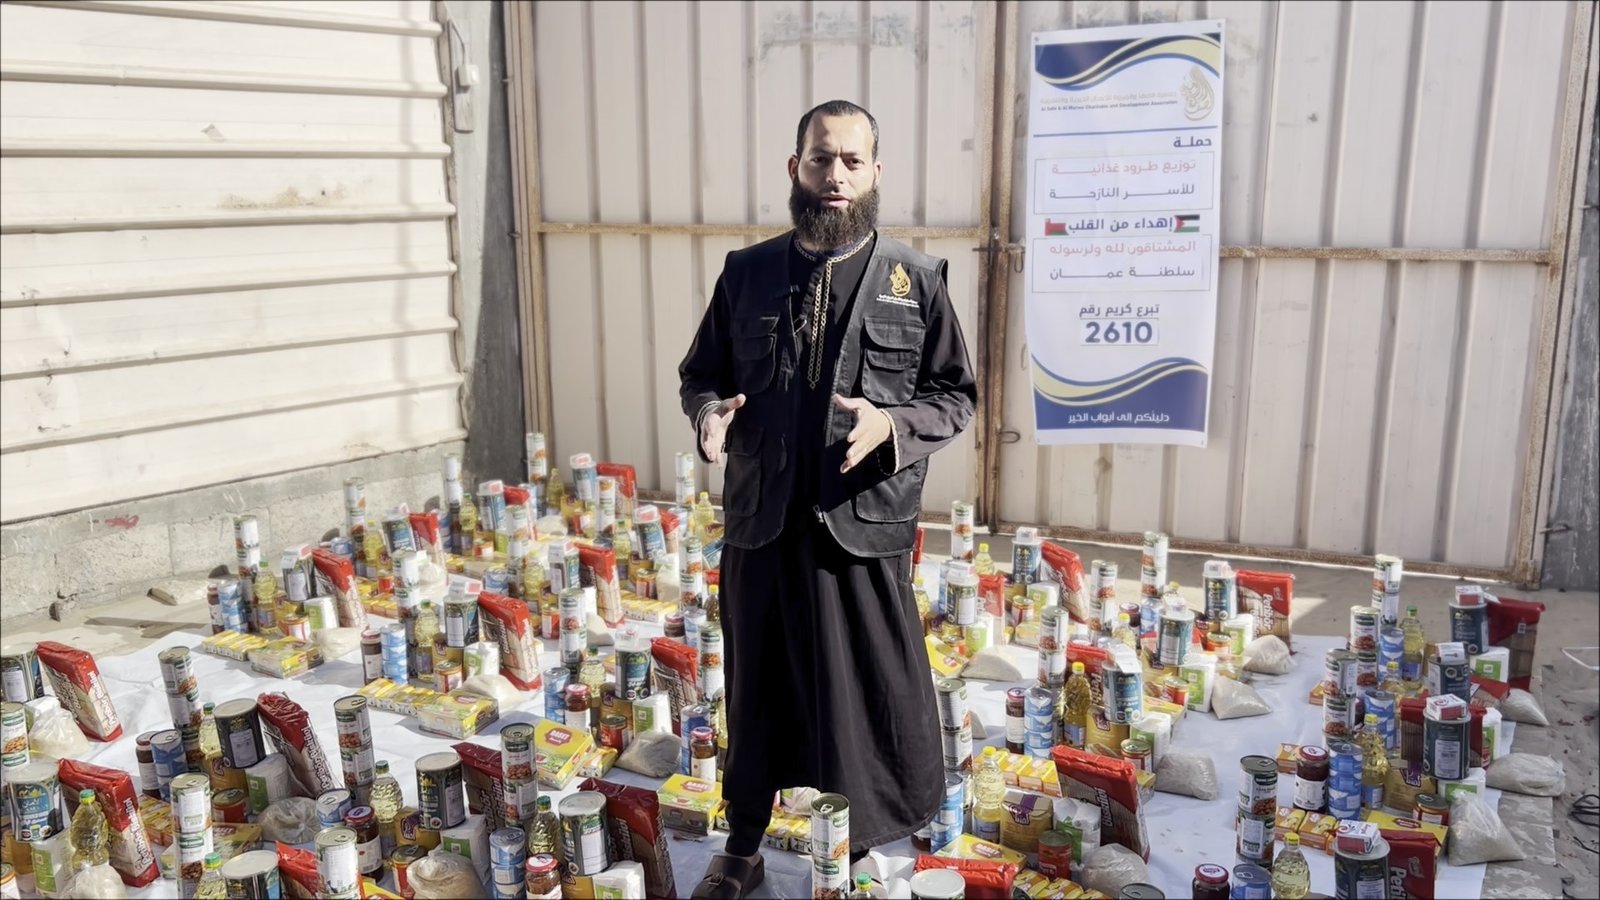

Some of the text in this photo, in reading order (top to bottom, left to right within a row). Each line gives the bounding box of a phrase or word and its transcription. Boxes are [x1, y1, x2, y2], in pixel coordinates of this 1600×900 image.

[1173, 136, 1212, 148] حملة
[1123, 160, 1158, 175] طرود
[1162, 160, 1196, 173] توزيع
[1049, 187, 1119, 200] النازحة
[1068, 217, 1173, 233] إهداء من القلب
[1050, 240, 1196, 257] المشتاقون لله ولرسوله
[1050, 266, 1195, 280] سلطنة عمان
[1079, 303, 1160, 317] تبرع كريم رقم
[1085, 321, 1152, 343] 2610
[1068, 412, 1089, 424] الخير
[1263, 593, 1274, 630] Petibör
[1090, 672, 1102, 704] Petib
[133, 831, 152, 866] Petibör
